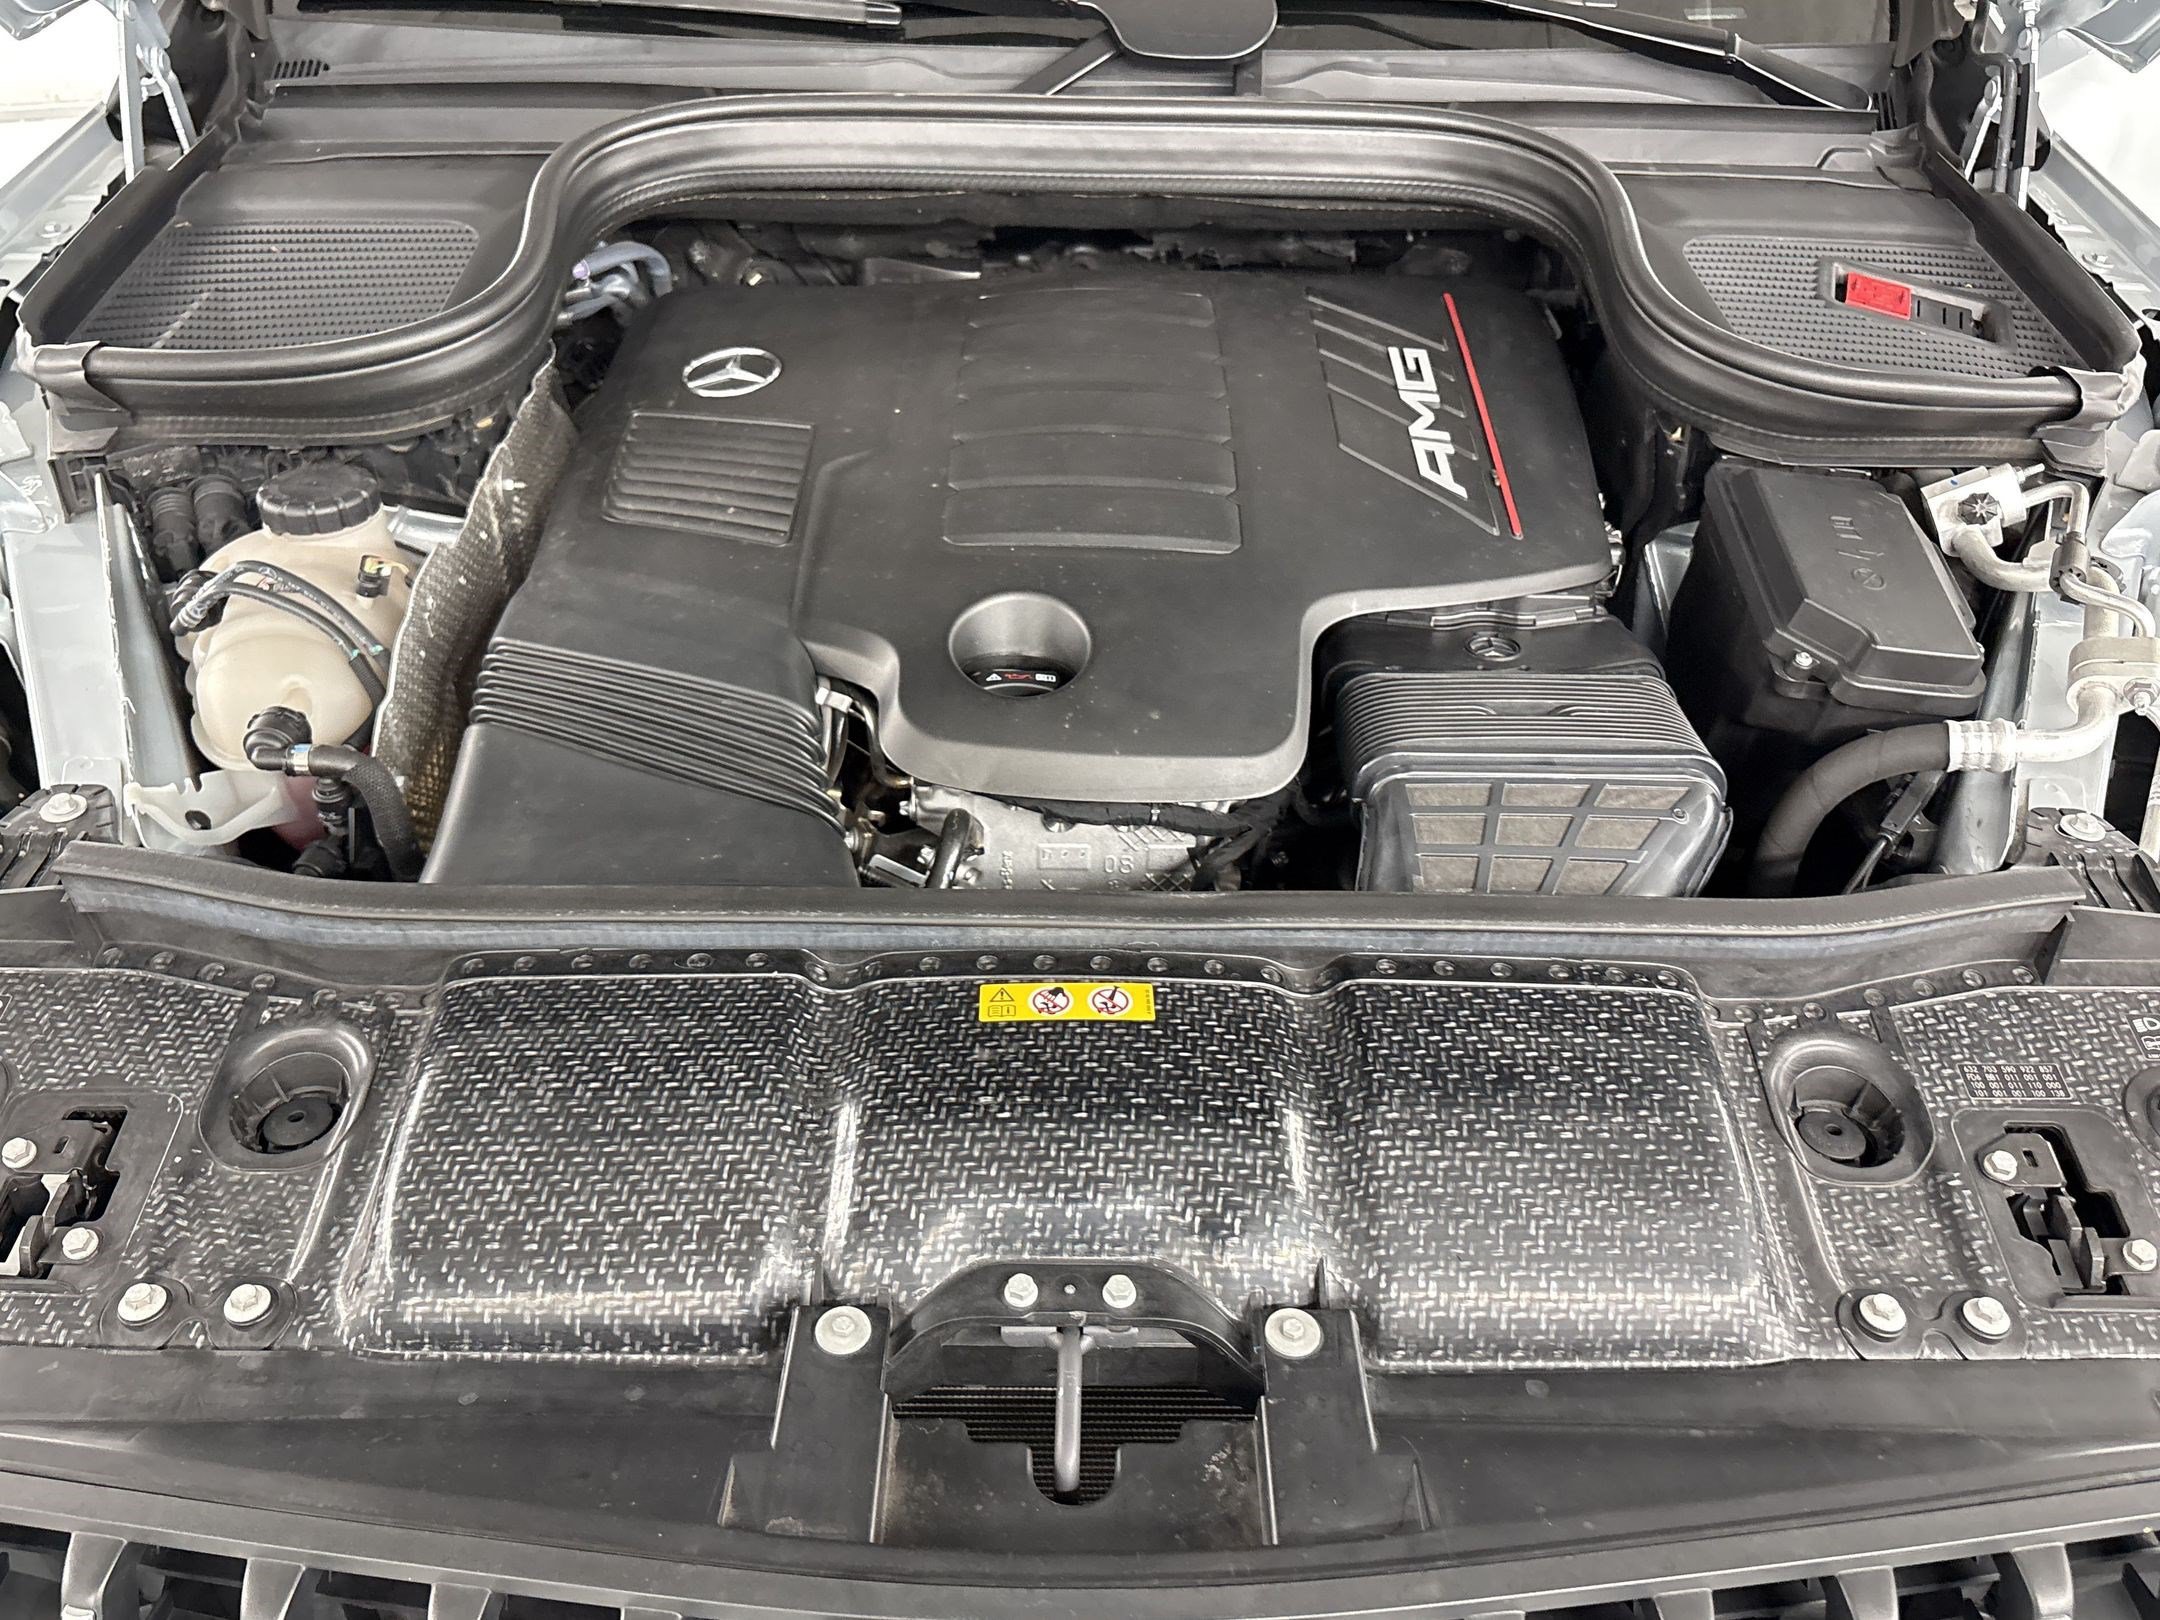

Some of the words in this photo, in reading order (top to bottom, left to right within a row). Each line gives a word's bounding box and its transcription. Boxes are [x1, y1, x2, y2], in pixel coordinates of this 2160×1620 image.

[1388, 347, 1468, 499] AMG
[1963, 1065, 1979, 1073] 632
[1981, 1065, 1998, 1073] 703
[2000, 1065, 2016, 1073] 590
[2019, 1065, 2036, 1073] 922
[2038, 1065, 2053, 1073] 857
[2004, 1073, 2020, 1081] 011
[2023, 1073, 2039, 1081] 001
[2041, 1073, 2058, 1081] 001
[1970, 1081, 1986, 1089] 100
[1988, 1081, 2004, 1089] 001
[2007, 1081, 2023, 1089] 011
[2027, 1081, 2043, 1089] 110
[2045, 1081, 2062, 1089] 000
[1973, 1089, 1989, 1097] 101
[1991, 1089, 2008, 1097] 001
[2011, 1089, 2027, 1097] 001
[2030, 1089, 2047, 1097] 100
